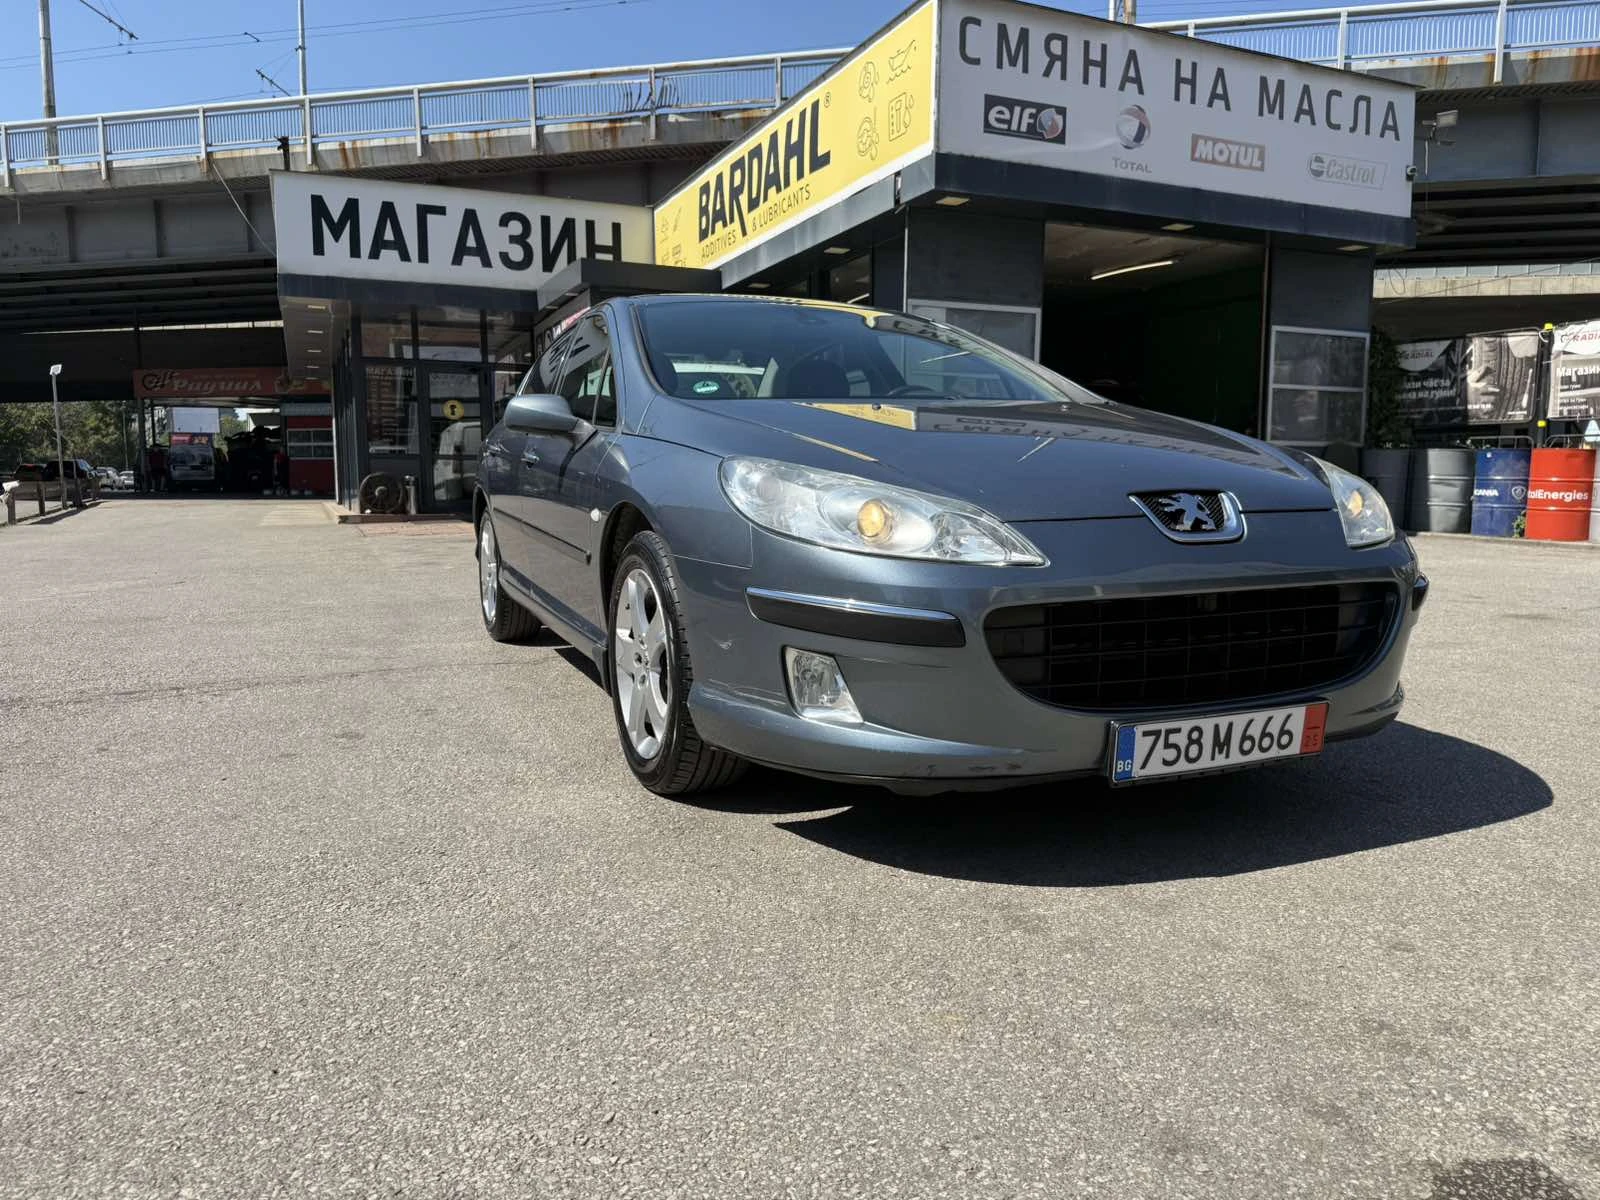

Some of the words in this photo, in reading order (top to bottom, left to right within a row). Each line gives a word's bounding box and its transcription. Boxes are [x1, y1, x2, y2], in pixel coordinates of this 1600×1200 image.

[958, 16, 1145, 96] СМЯНА
[1174, 58, 1231, 112] НА
[1257, 75, 1401, 141] МАСЛА
[988, 105, 1037, 132] elf
[1193, 138, 1263, 168] MOTUL
[699, 98, 831, 243] BARDAHL
[1325, 158, 1377, 185] Castrol
[310, 193, 622, 273] МАГАЗИН
[701, 229, 737, 260] ADDITIVES
[758, 183, 812, 228] LUBRICANTS
[1474, 488, 1499, 497] CANIA
[1527, 488, 1589, 502] talEnergies
[1116, 759, 1132, 773] BG
